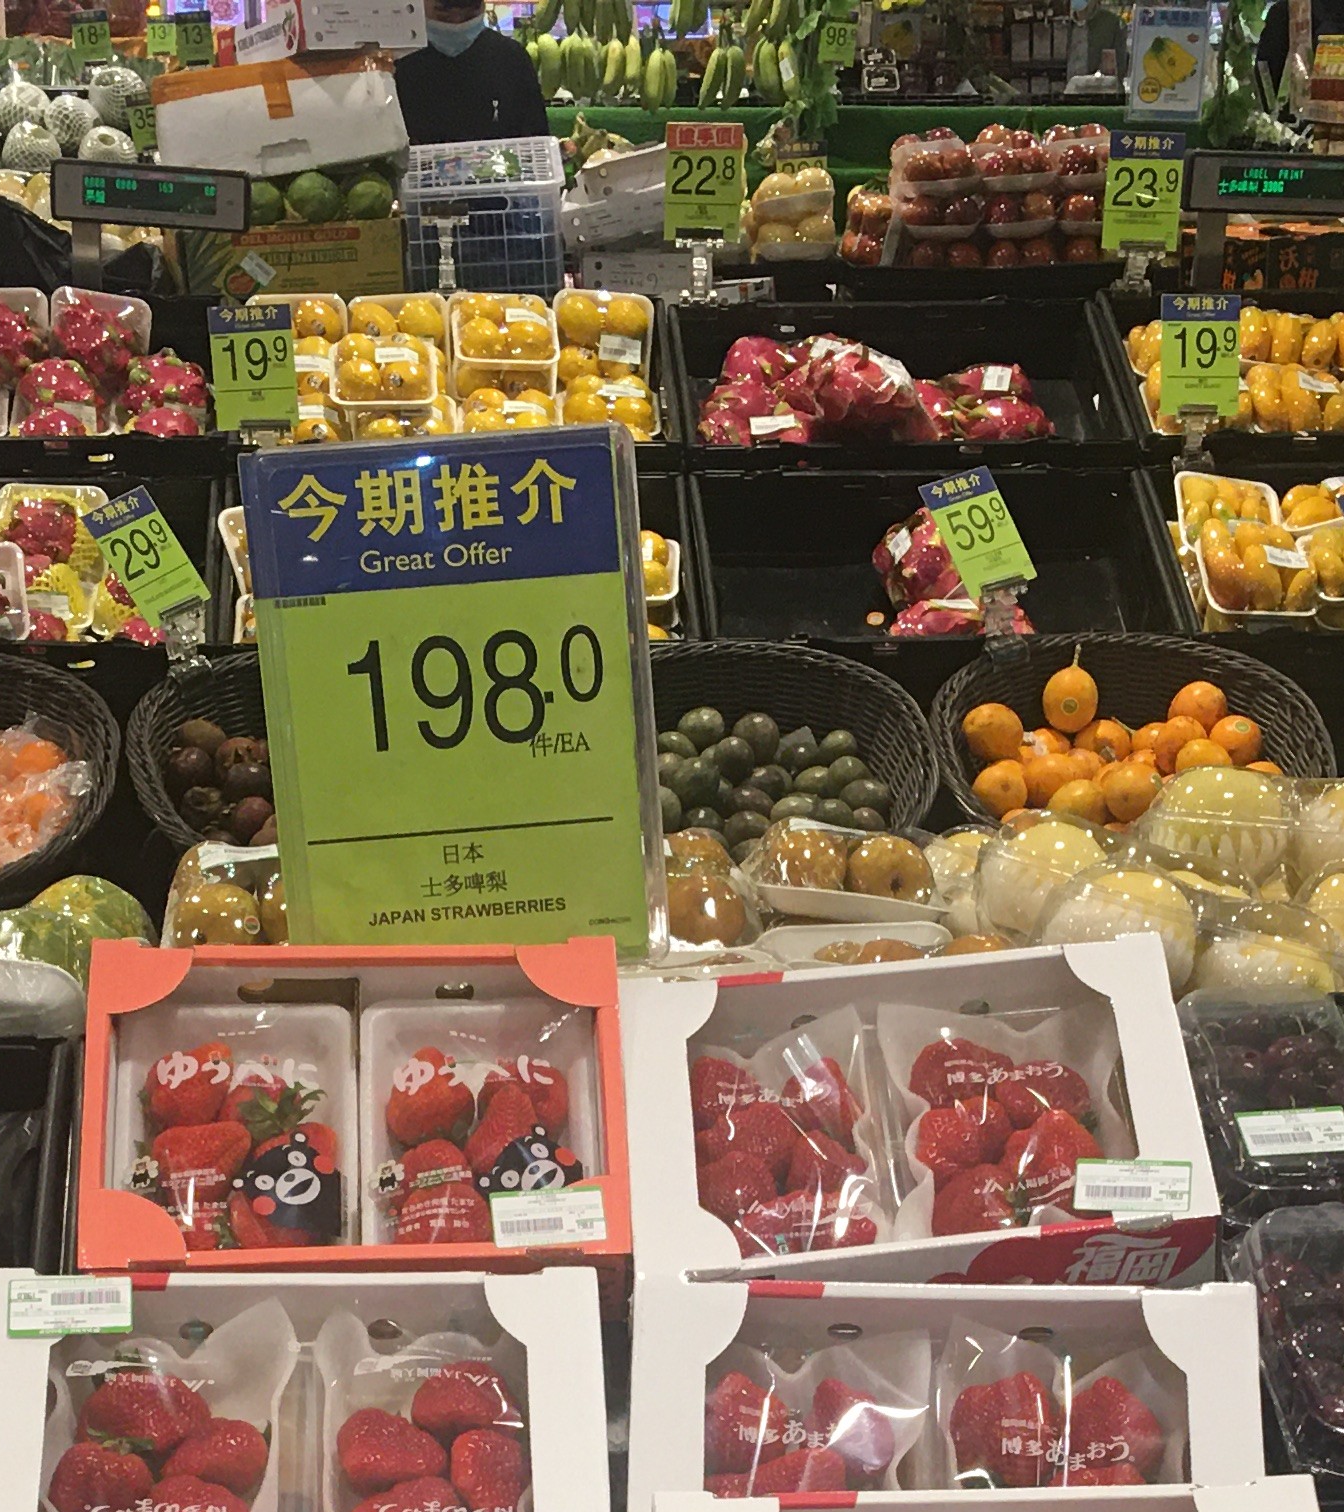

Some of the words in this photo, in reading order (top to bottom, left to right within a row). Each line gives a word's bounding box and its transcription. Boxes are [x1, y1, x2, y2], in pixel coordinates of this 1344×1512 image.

[1120, 136, 1175, 150] 今期推介
[671, 155, 735, 196] 22.8
[1111, 166, 1179, 209] 23.9
[217, 304, 279, 322] 今期推介
[1171, 296, 1233, 312] 今期推介
[219, 331, 289, 384] 19.9
[1171, 325, 1237, 370] 19.9
[277, 457, 577, 542] 今期推介
[926, 472, 983, 500] 今期推介
[90, 495, 141, 526] 今期推介
[943, 496, 1007, 551] 59.9
[109, 526, 168, 582] 29.9
[359, 549, 436, 574] Great
[442, 542, 513, 568] Offer
[346, 624, 605, 752] 198.0
[529, 731, 591, 759] 件/EA
[442, 842, 484, 865] 日本
[420, 871, 508, 898] 士多啤梨
[368, 906, 426, 927] JAPAN
[430, 897, 567, 922] STRAWBERRIES
[1064, 1240, 1183, 1286] 福岡
